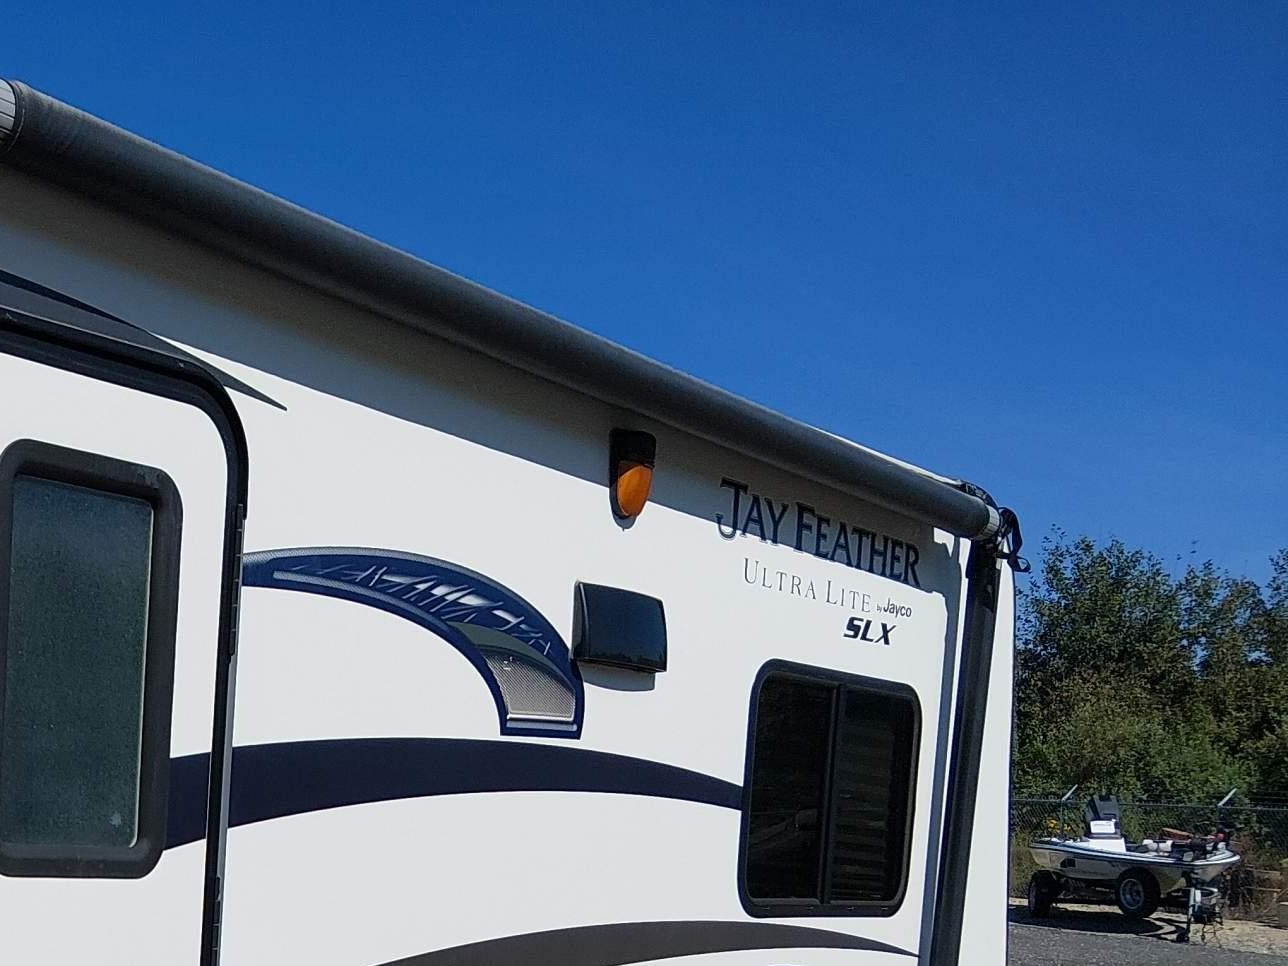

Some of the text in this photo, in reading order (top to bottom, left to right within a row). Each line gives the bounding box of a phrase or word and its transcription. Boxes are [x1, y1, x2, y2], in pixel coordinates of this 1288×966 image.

[716, 477, 921, 587] JAY FEATHER
[744, 558, 817, 600] ULTRA
[826, 580, 872, 612] LITE
[883, 597, 912, 618] Jayco
[843, 616, 897, 645] SLX
